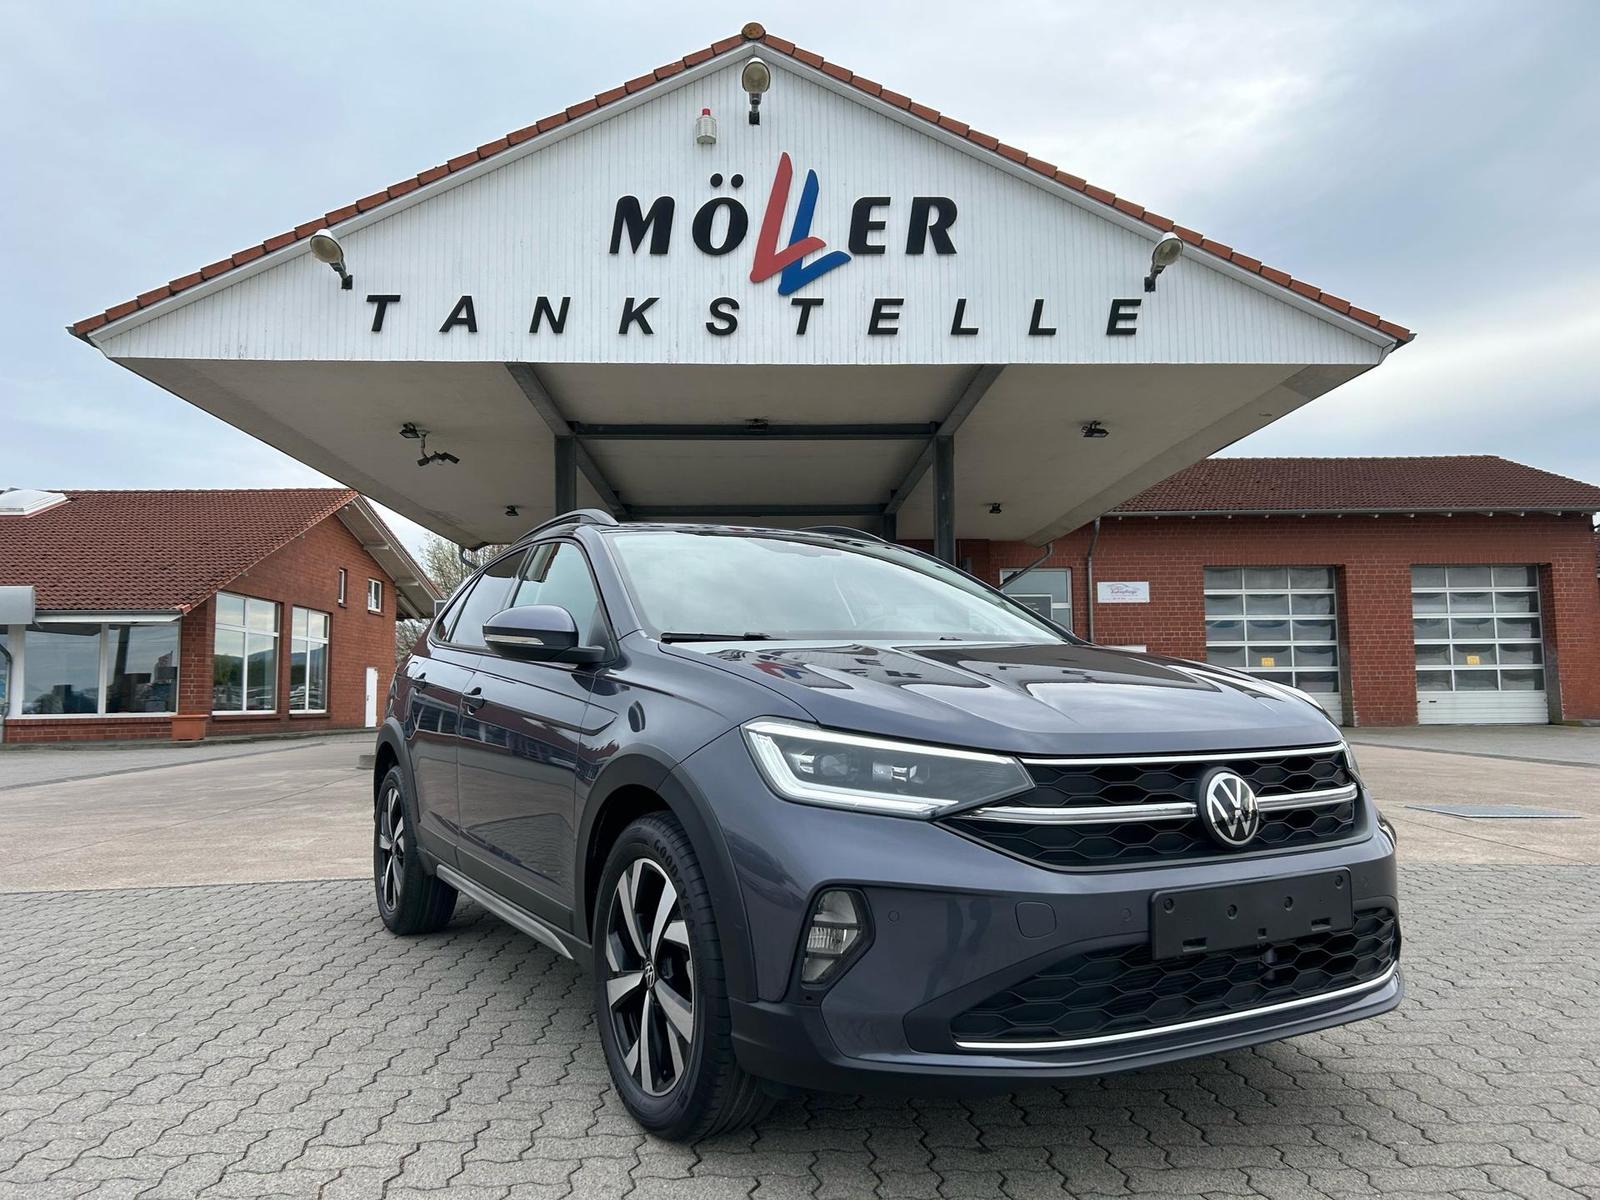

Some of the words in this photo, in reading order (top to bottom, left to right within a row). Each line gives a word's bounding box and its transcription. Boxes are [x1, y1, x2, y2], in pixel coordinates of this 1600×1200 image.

[609, 152, 959, 296] MÖLLER
[367, 294, 1141, 338] TANKSTELLE
[1203, 769, 1258, 844] VW
